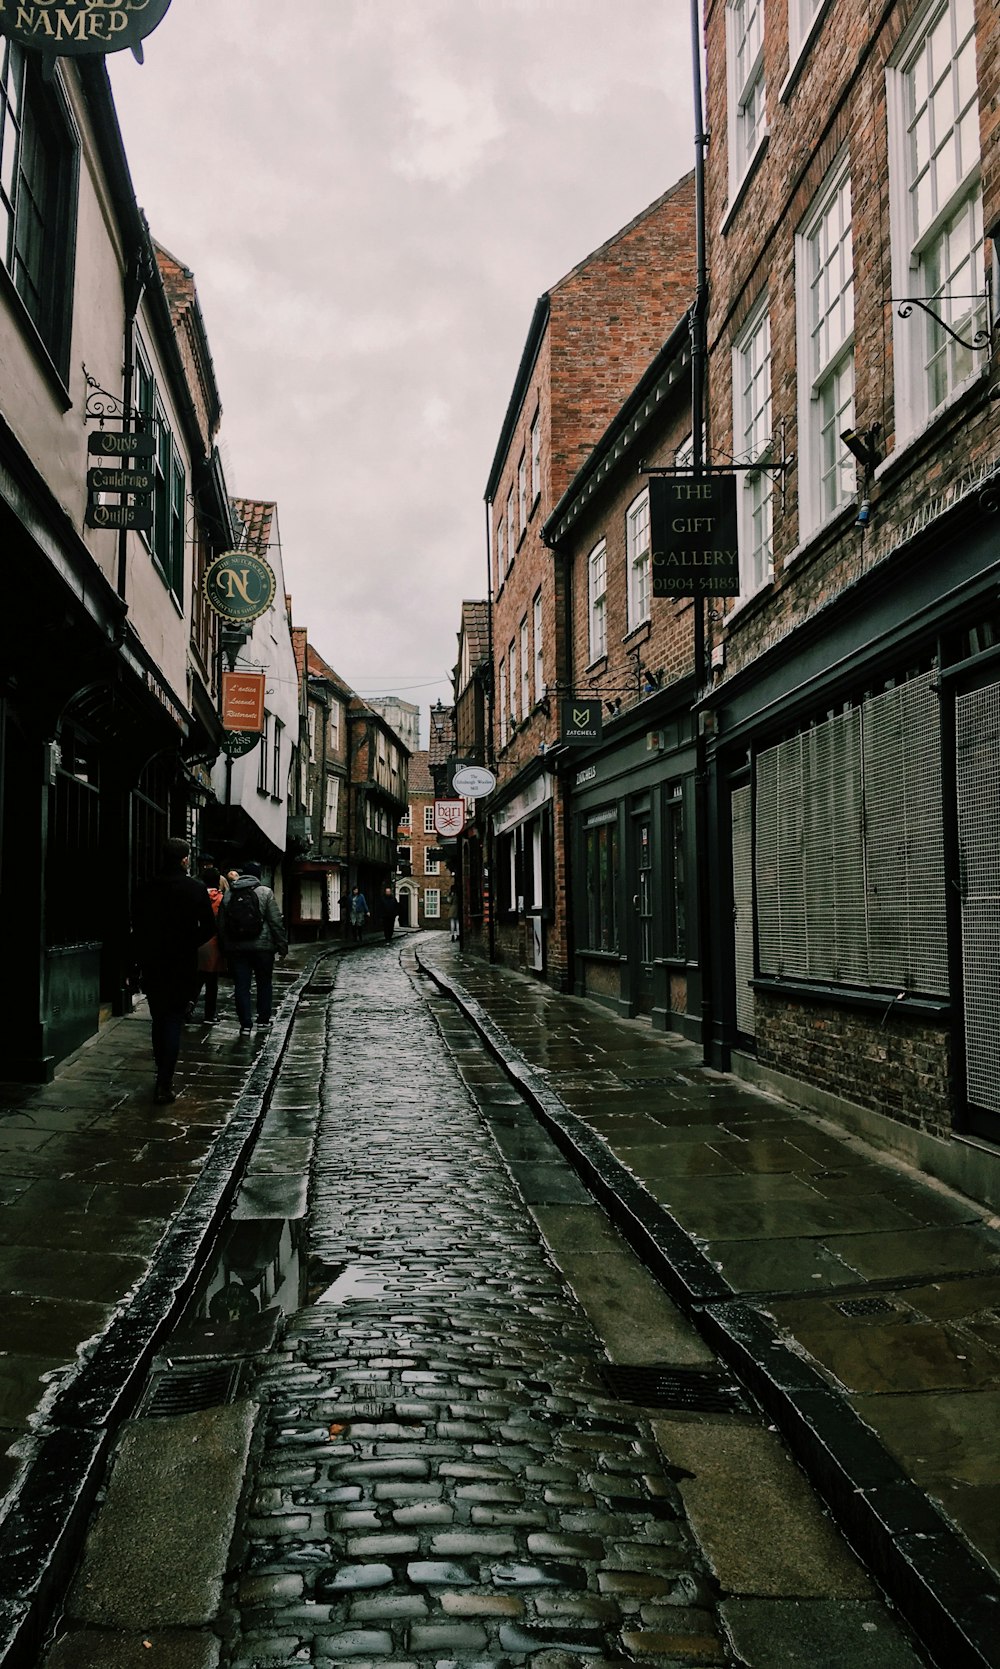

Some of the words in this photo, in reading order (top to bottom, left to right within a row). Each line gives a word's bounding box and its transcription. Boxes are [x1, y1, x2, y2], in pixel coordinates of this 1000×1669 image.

[15, 6, 129, 41] NAMED
[92, 469, 149, 488] Cauldrons
[671, 484, 712, 500] THE
[93, 505, 135, 527] Quills
[671, 517, 715, 533] GIFT
[652, 550, 738, 566] GALLERY
[215, 568, 261, 605] N
[653, 577, 694, 590] 01904
[698, 576, 739, 590] 541851
[210, 591, 241, 615] CHRISTMAS
[437, 803, 461, 818] bari
